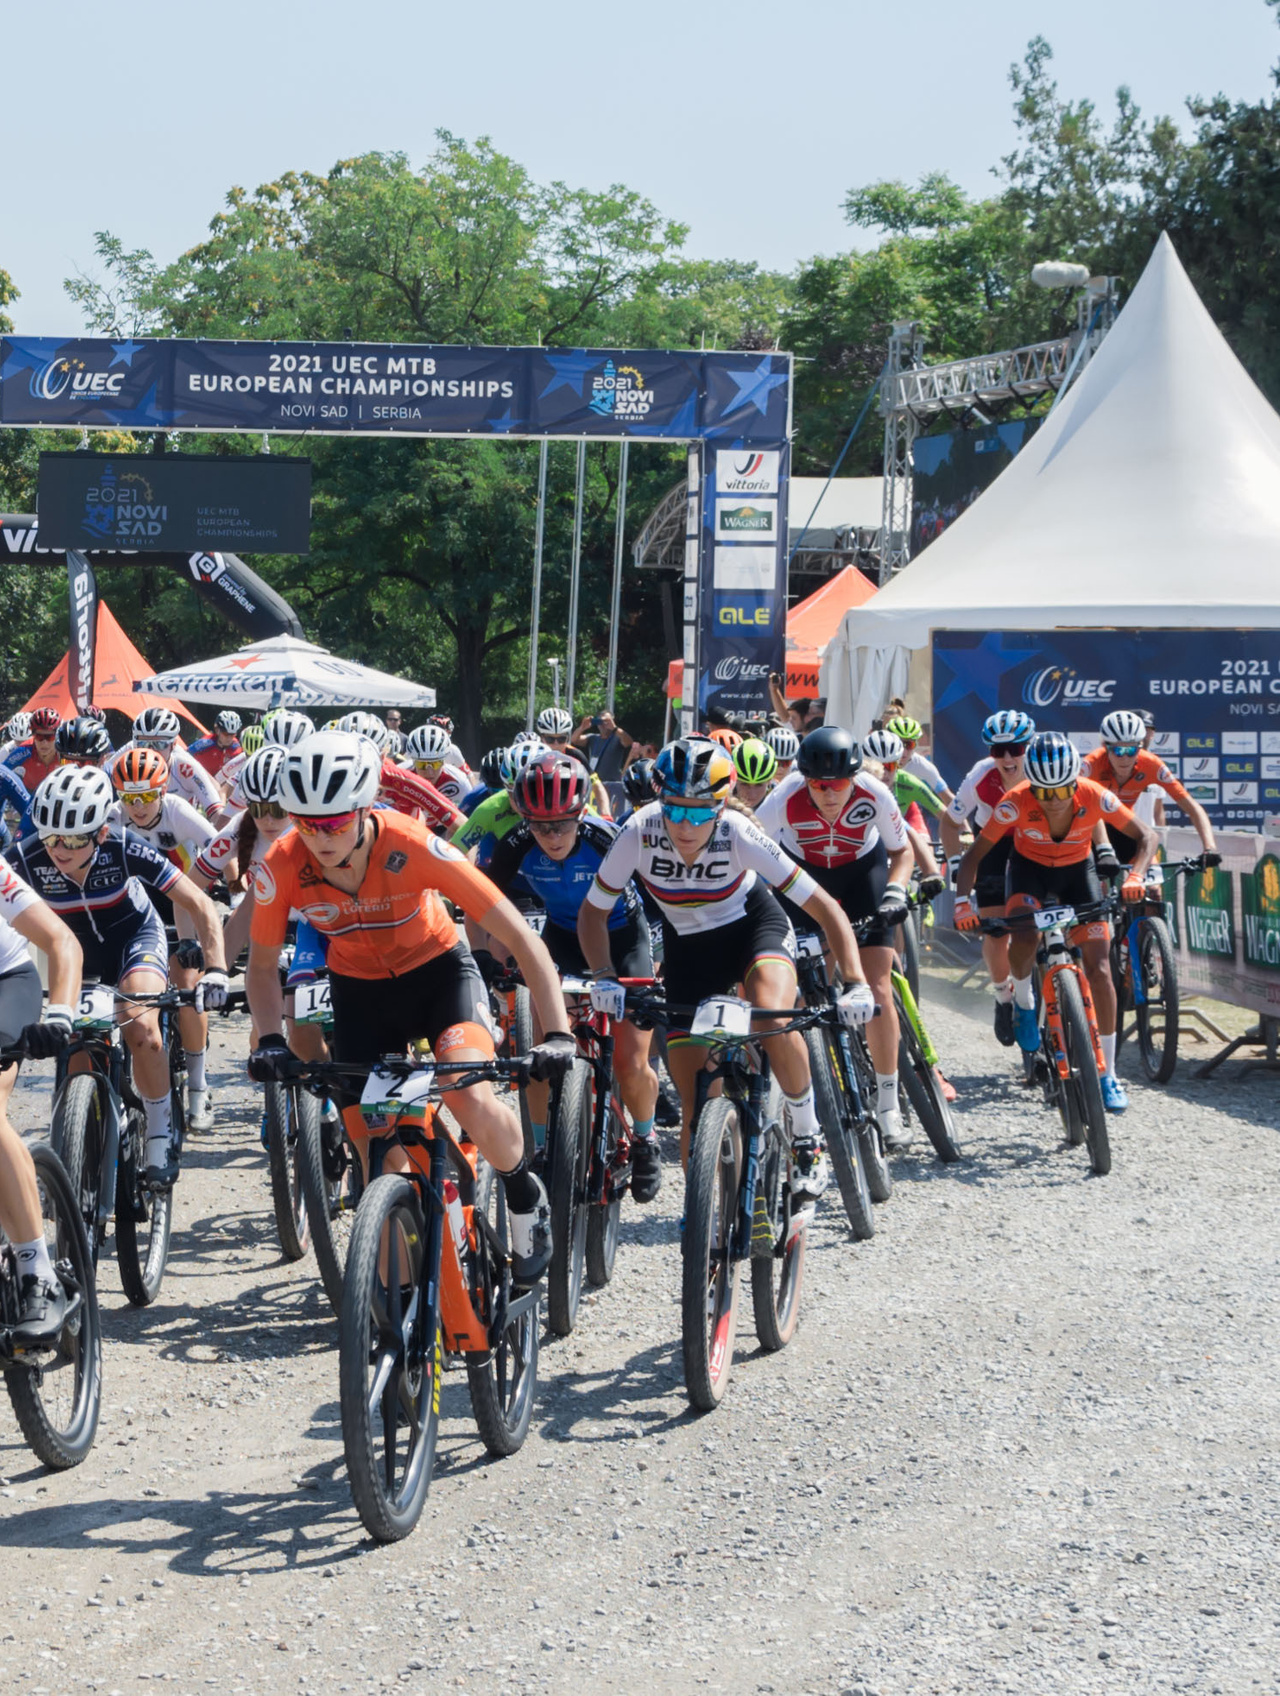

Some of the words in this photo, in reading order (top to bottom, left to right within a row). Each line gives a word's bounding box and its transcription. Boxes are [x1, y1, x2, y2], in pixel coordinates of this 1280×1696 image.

[269, 354, 323, 373] 2021
[332, 356, 378, 374] UEC
[387, 357, 437, 375] MTB
[72, 372, 126, 392] UEC
[189, 374, 313, 395] EUROPEAN
[320, 377, 514, 398] CHAMPIONSHIPS
[592, 377, 632, 389] 2021
[615, 390, 655, 403] NOVI
[281, 404, 315, 417] NOVI
[320, 405, 349, 418] SAD
[373, 406, 422, 419] SERBIA
[614, 402, 651, 414] SAD
[725, 479, 770, 491] vittoria
[86, 487, 137, 501] 2021
[117, 505, 167, 521] NOVI
[115, 521, 162, 536] SAD
[724, 517, 769, 529] WAGNER
[218, 577, 257, 615] GRAPHENE
[739, 663, 770, 675] UEC
[1221, 660, 1270, 676] 2021
[1064, 680, 1117, 698] UEC
[1149, 680, 1263, 695] EUROPEAN
[1229, 703, 1263, 716] NOVI
[403, 785, 440, 813] postnord
[650, 855, 730, 880] BMC
[1187, 905, 1233, 954] WAGNER
[79, 991, 95, 1015] 5
[714, 1003, 726, 1028] 1
[384, 1073, 410, 1099] 2
